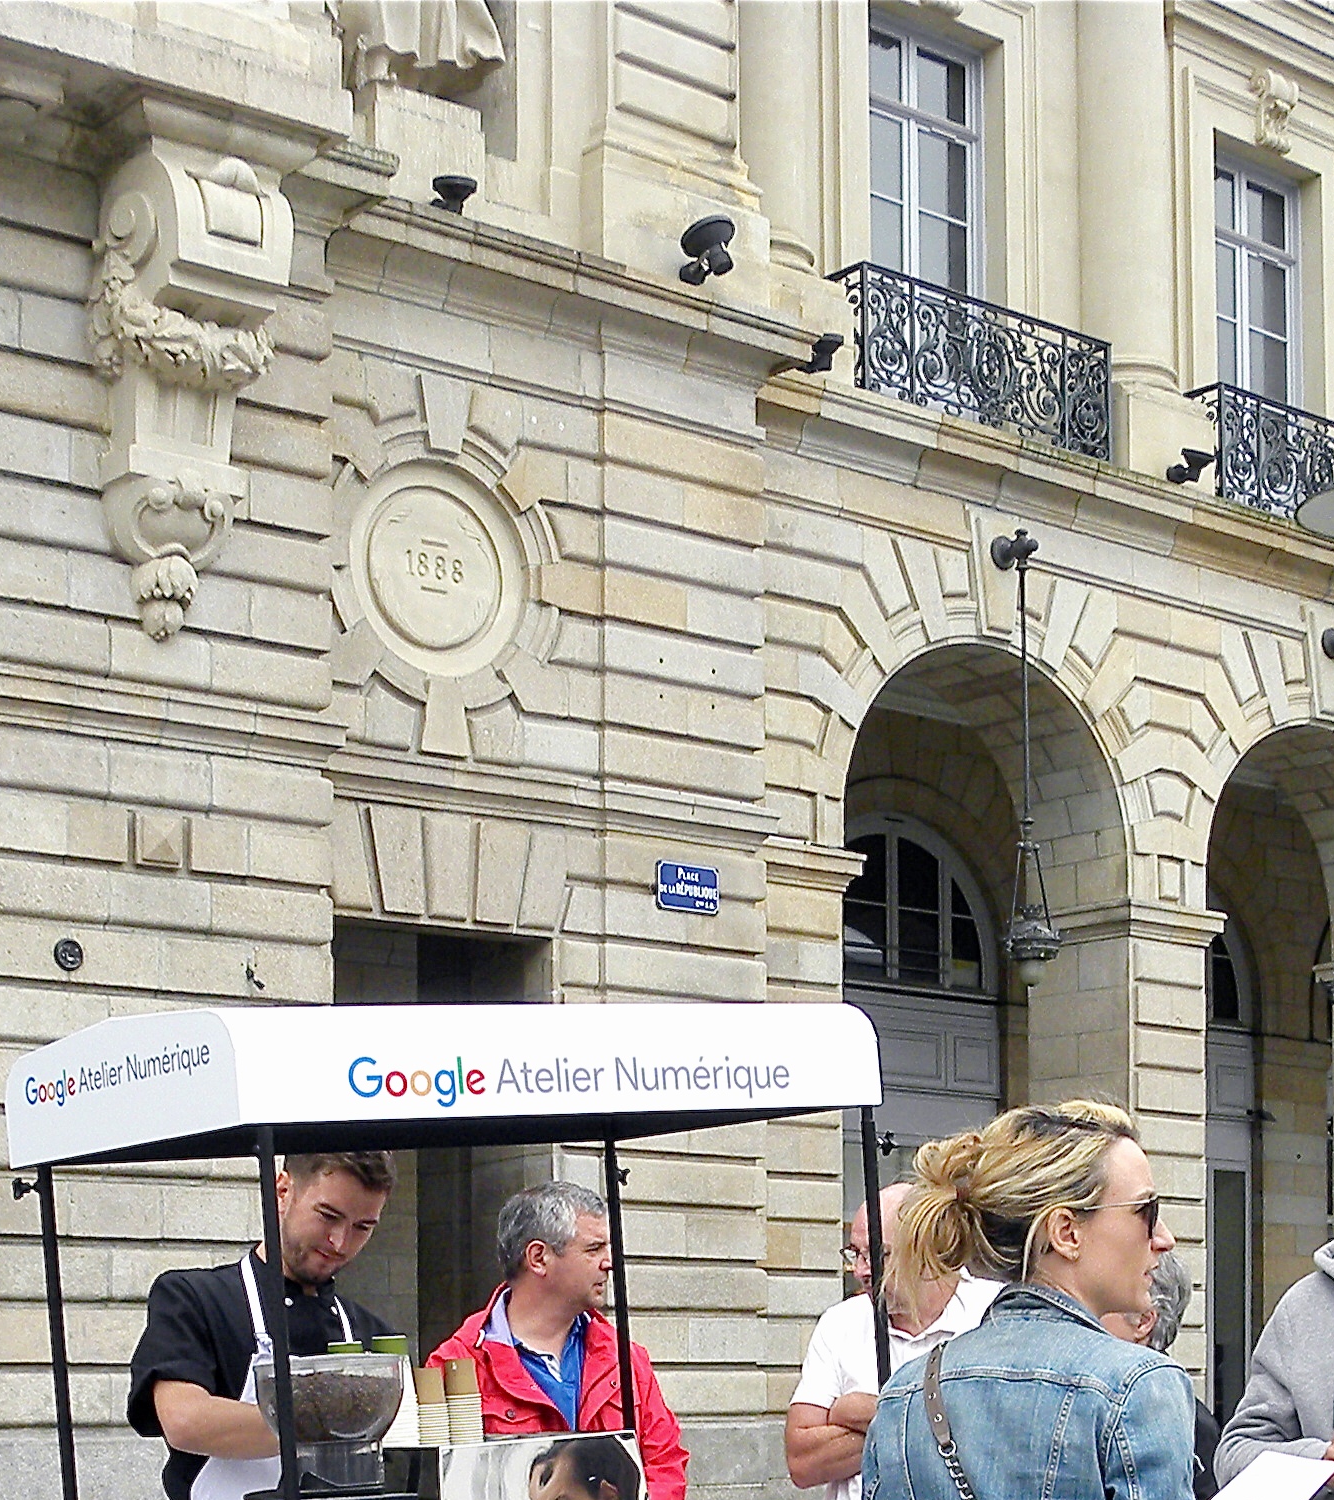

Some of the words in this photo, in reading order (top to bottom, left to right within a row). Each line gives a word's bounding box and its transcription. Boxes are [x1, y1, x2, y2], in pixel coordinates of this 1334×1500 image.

[405, 548, 465, 585] 1888
[25, 1069, 76, 1107] Google
[78, 1061, 123, 1093] Atelier
[126, 1043, 211, 1082] Numérique
[348, 1056, 486, 1108] Google
[496, 1058, 604, 1094] Atelier
[615, 1055, 790, 1099] Numérique
